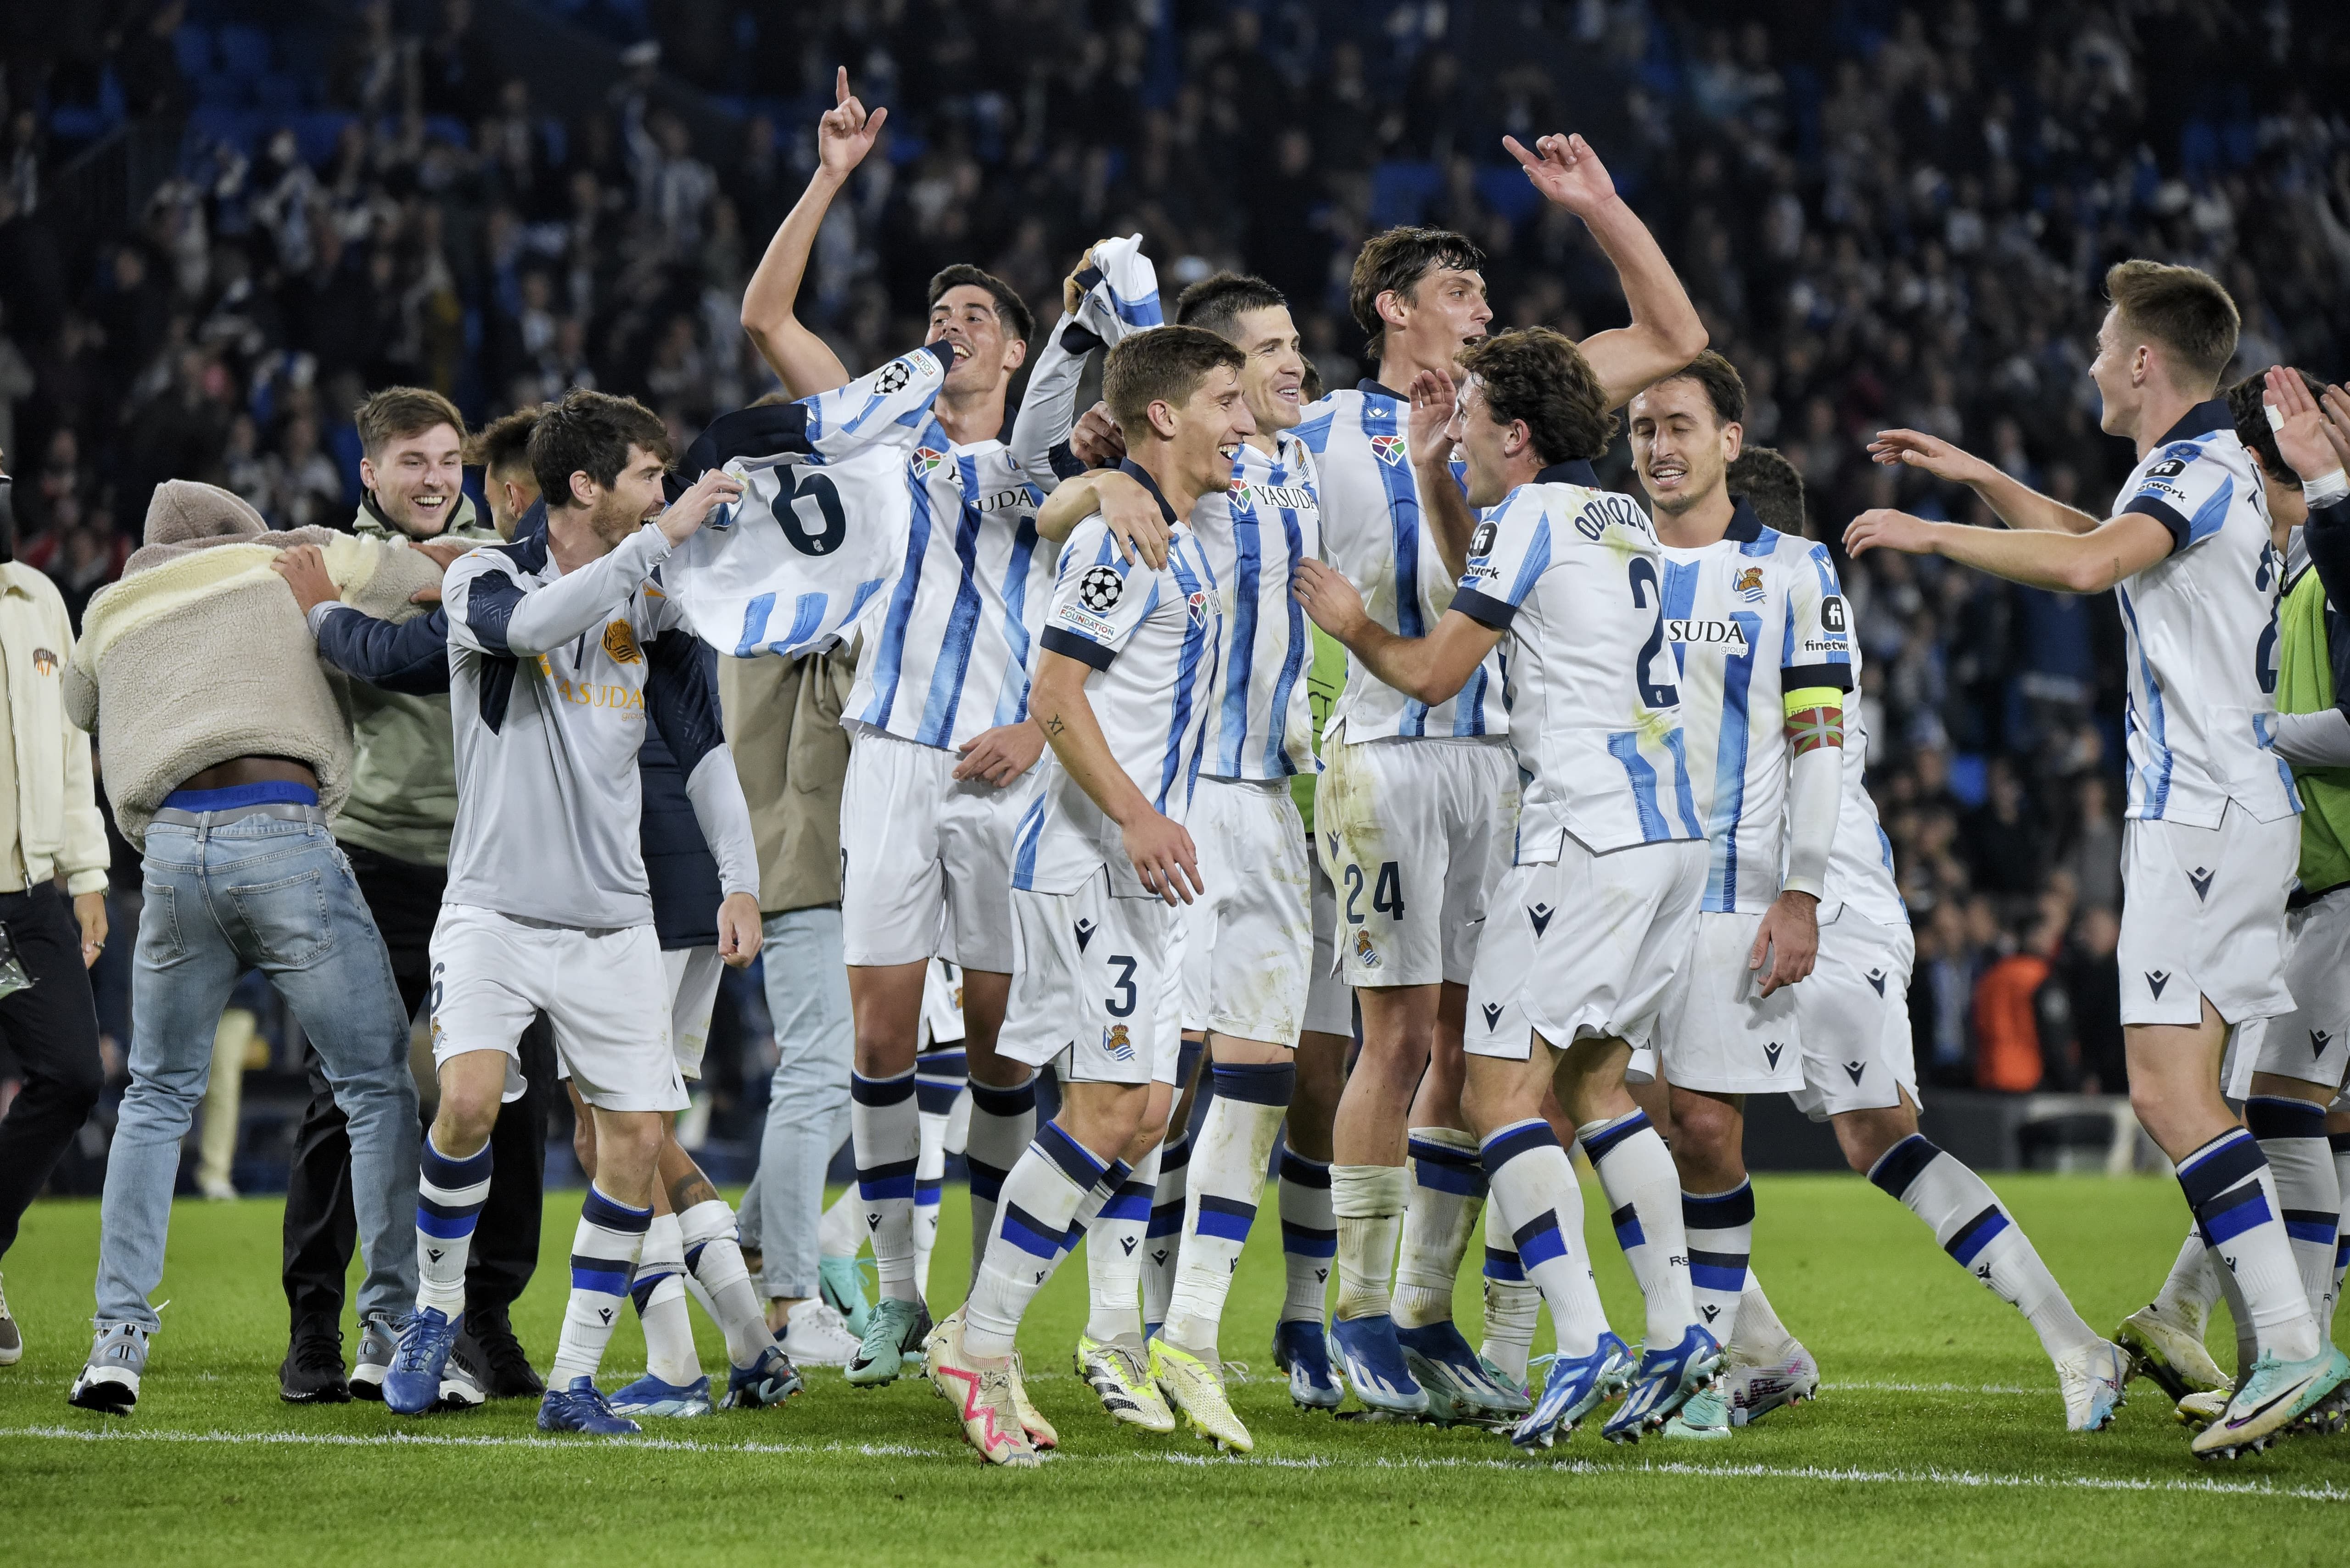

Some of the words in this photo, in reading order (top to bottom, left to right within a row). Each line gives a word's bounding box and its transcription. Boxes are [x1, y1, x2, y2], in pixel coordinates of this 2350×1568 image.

[1253, 485, 1320, 511] YASUDA
[2137, 482, 2187, 503] etwork
[771, 463, 846, 557] 6
[1629, 557, 1680, 709] 2
[1668, 620, 1748, 645] SUDA
[1721, 646, 1747, 655] group
[554, 675, 644, 709] ASUDA
[621, 712, 644, 723] group
[1344, 861, 1405, 924] 24
[1105, 954, 1138, 1018] 3
